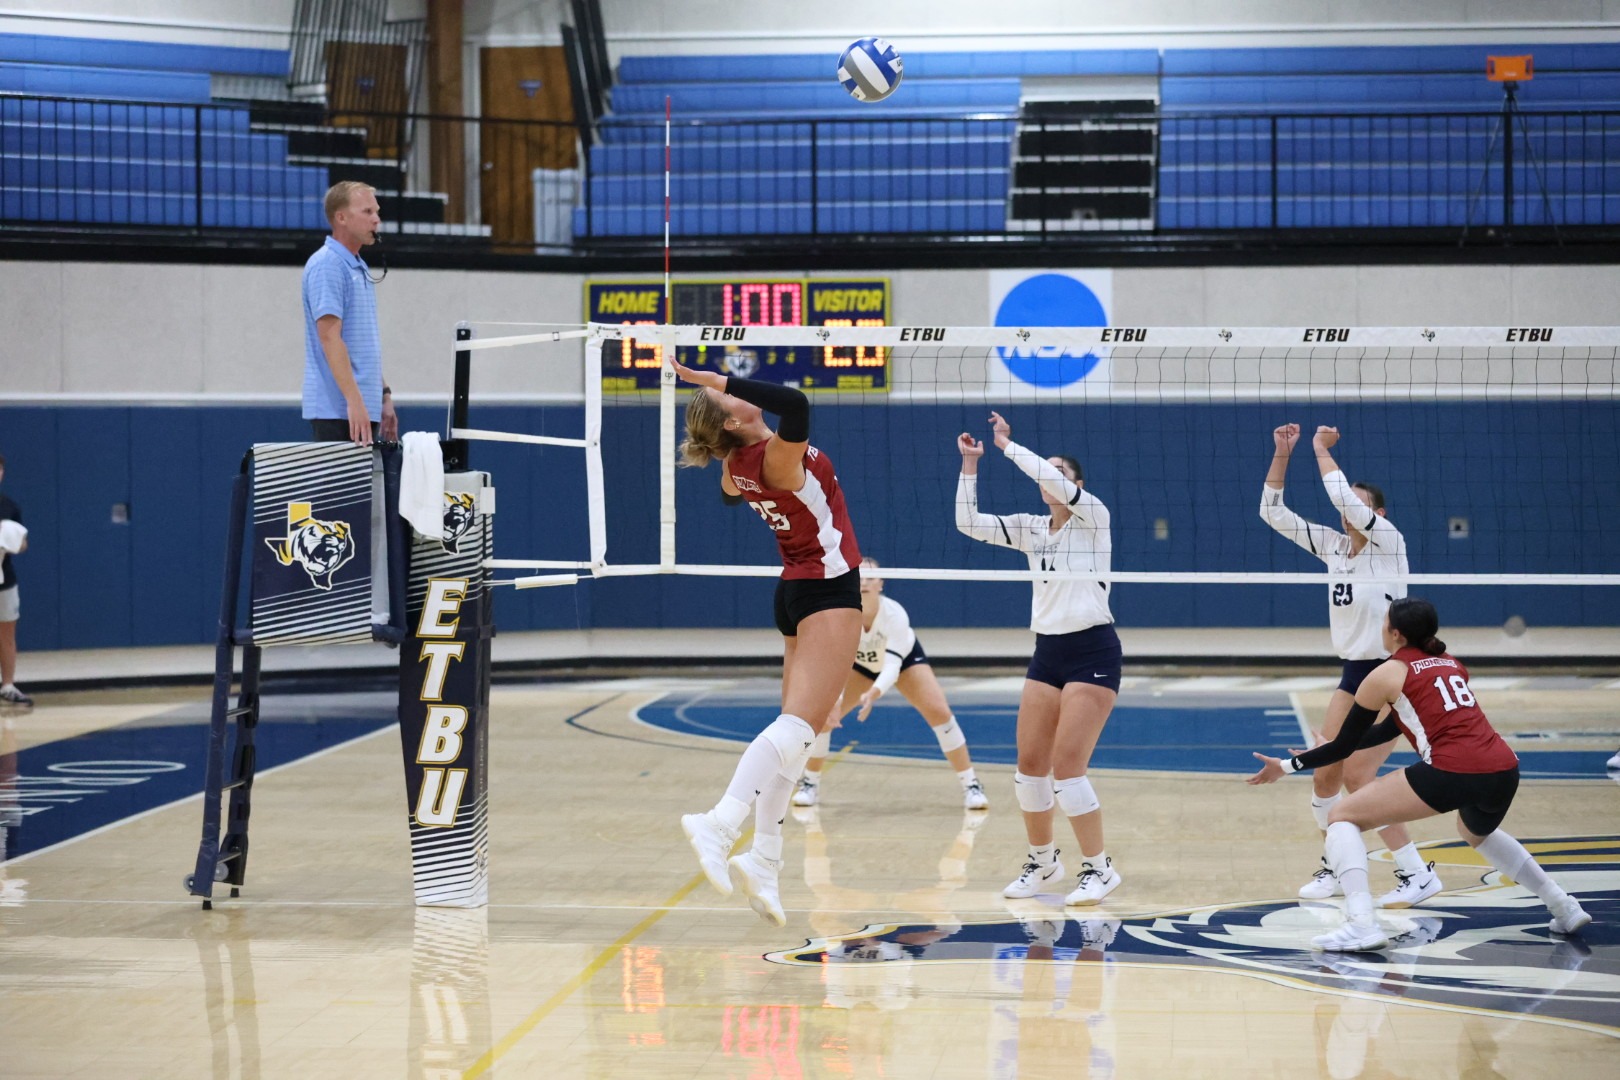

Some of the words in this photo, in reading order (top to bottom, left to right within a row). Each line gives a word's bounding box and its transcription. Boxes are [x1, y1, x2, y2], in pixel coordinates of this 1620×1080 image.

[598, 291, 660, 313] HOME
[813, 289, 883, 312] VISITOR
[700, 327, 746, 341] ETBU
[900, 328, 946, 342] ETBU
[1100, 328, 1147, 343] ETBU
[1303, 328, 1350, 343] ETBU
[1506, 328, 1553, 343] ETBU
[856, 650, 878, 662] 22
[1433, 674, 1476, 711] 18
[415, 578, 469, 828] ETBU
